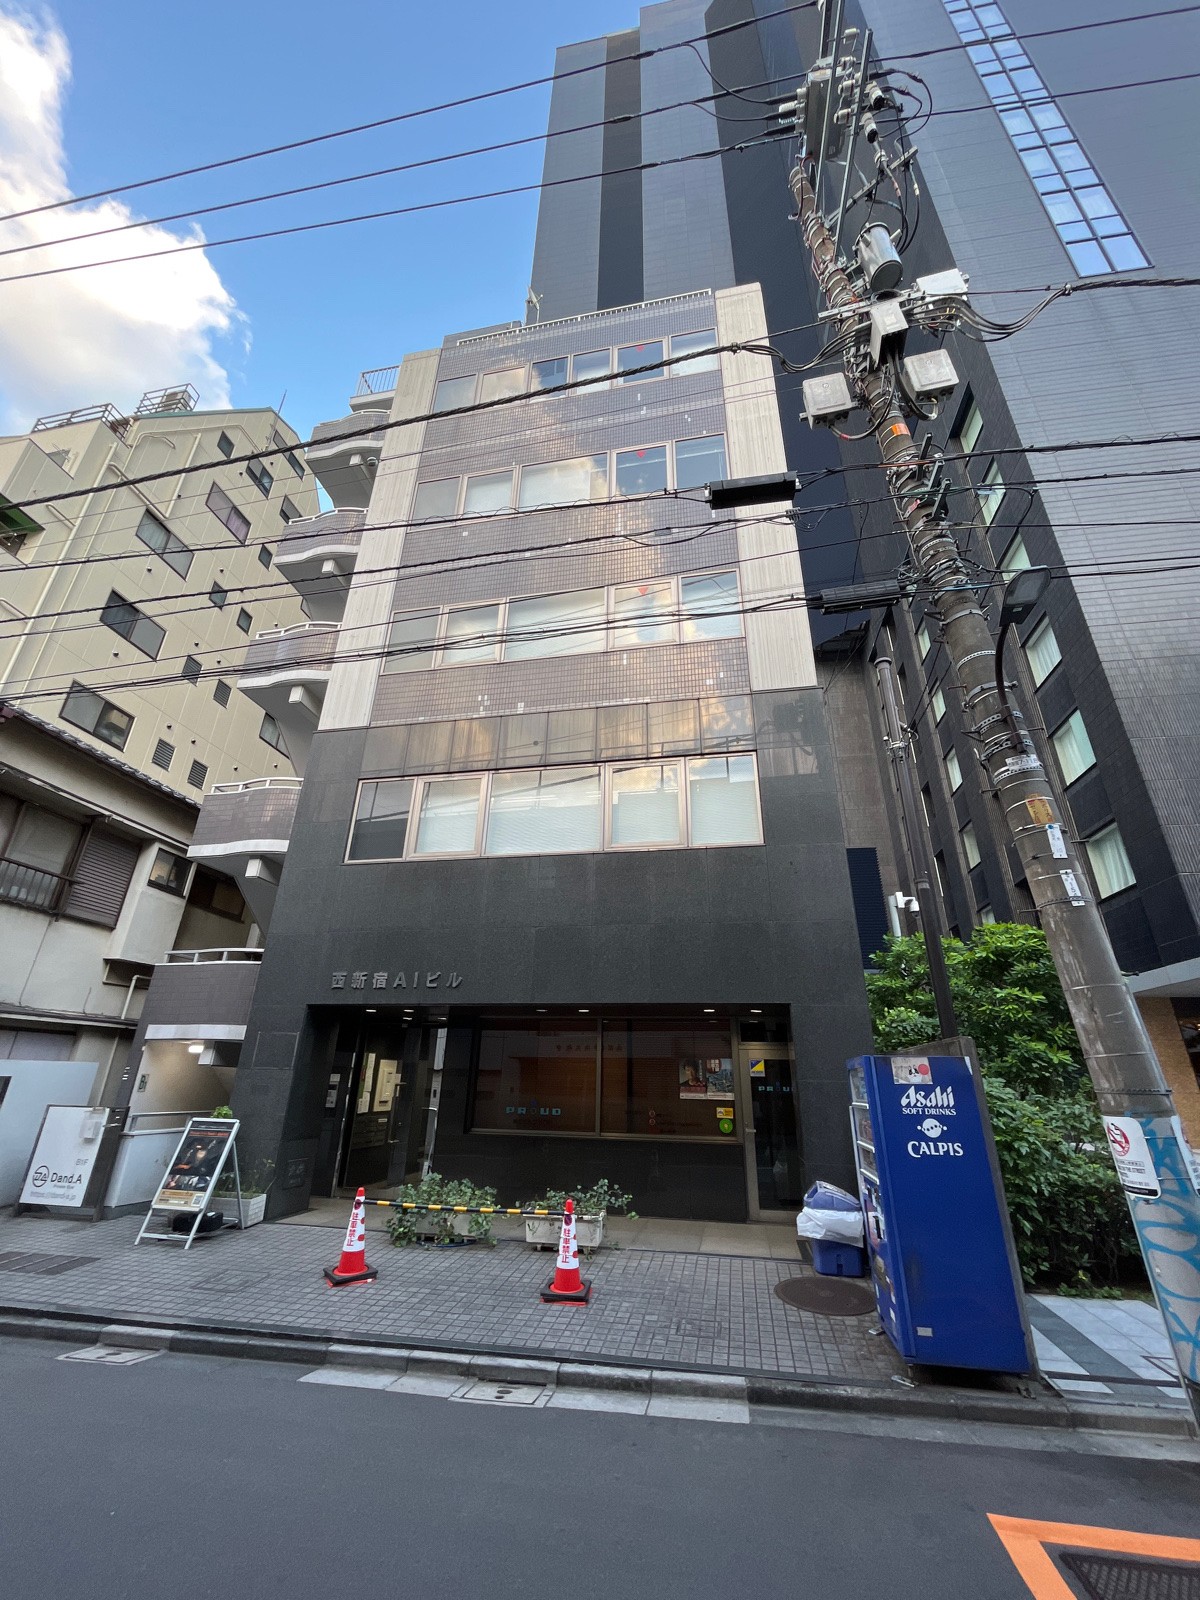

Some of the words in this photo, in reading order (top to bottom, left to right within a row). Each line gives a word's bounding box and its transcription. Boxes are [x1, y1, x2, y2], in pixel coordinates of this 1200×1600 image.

[900, 1085, 955, 1108] Asahi
[902, 1107, 923, 1115] SOFT
[925, 1108, 957, 1116] DRINKS
[907, 1140, 964, 1158] CALPIS
[346, 1212, 359, 1247] 駐車禁止
[561, 1228, 571, 1264] 駐車禁止
